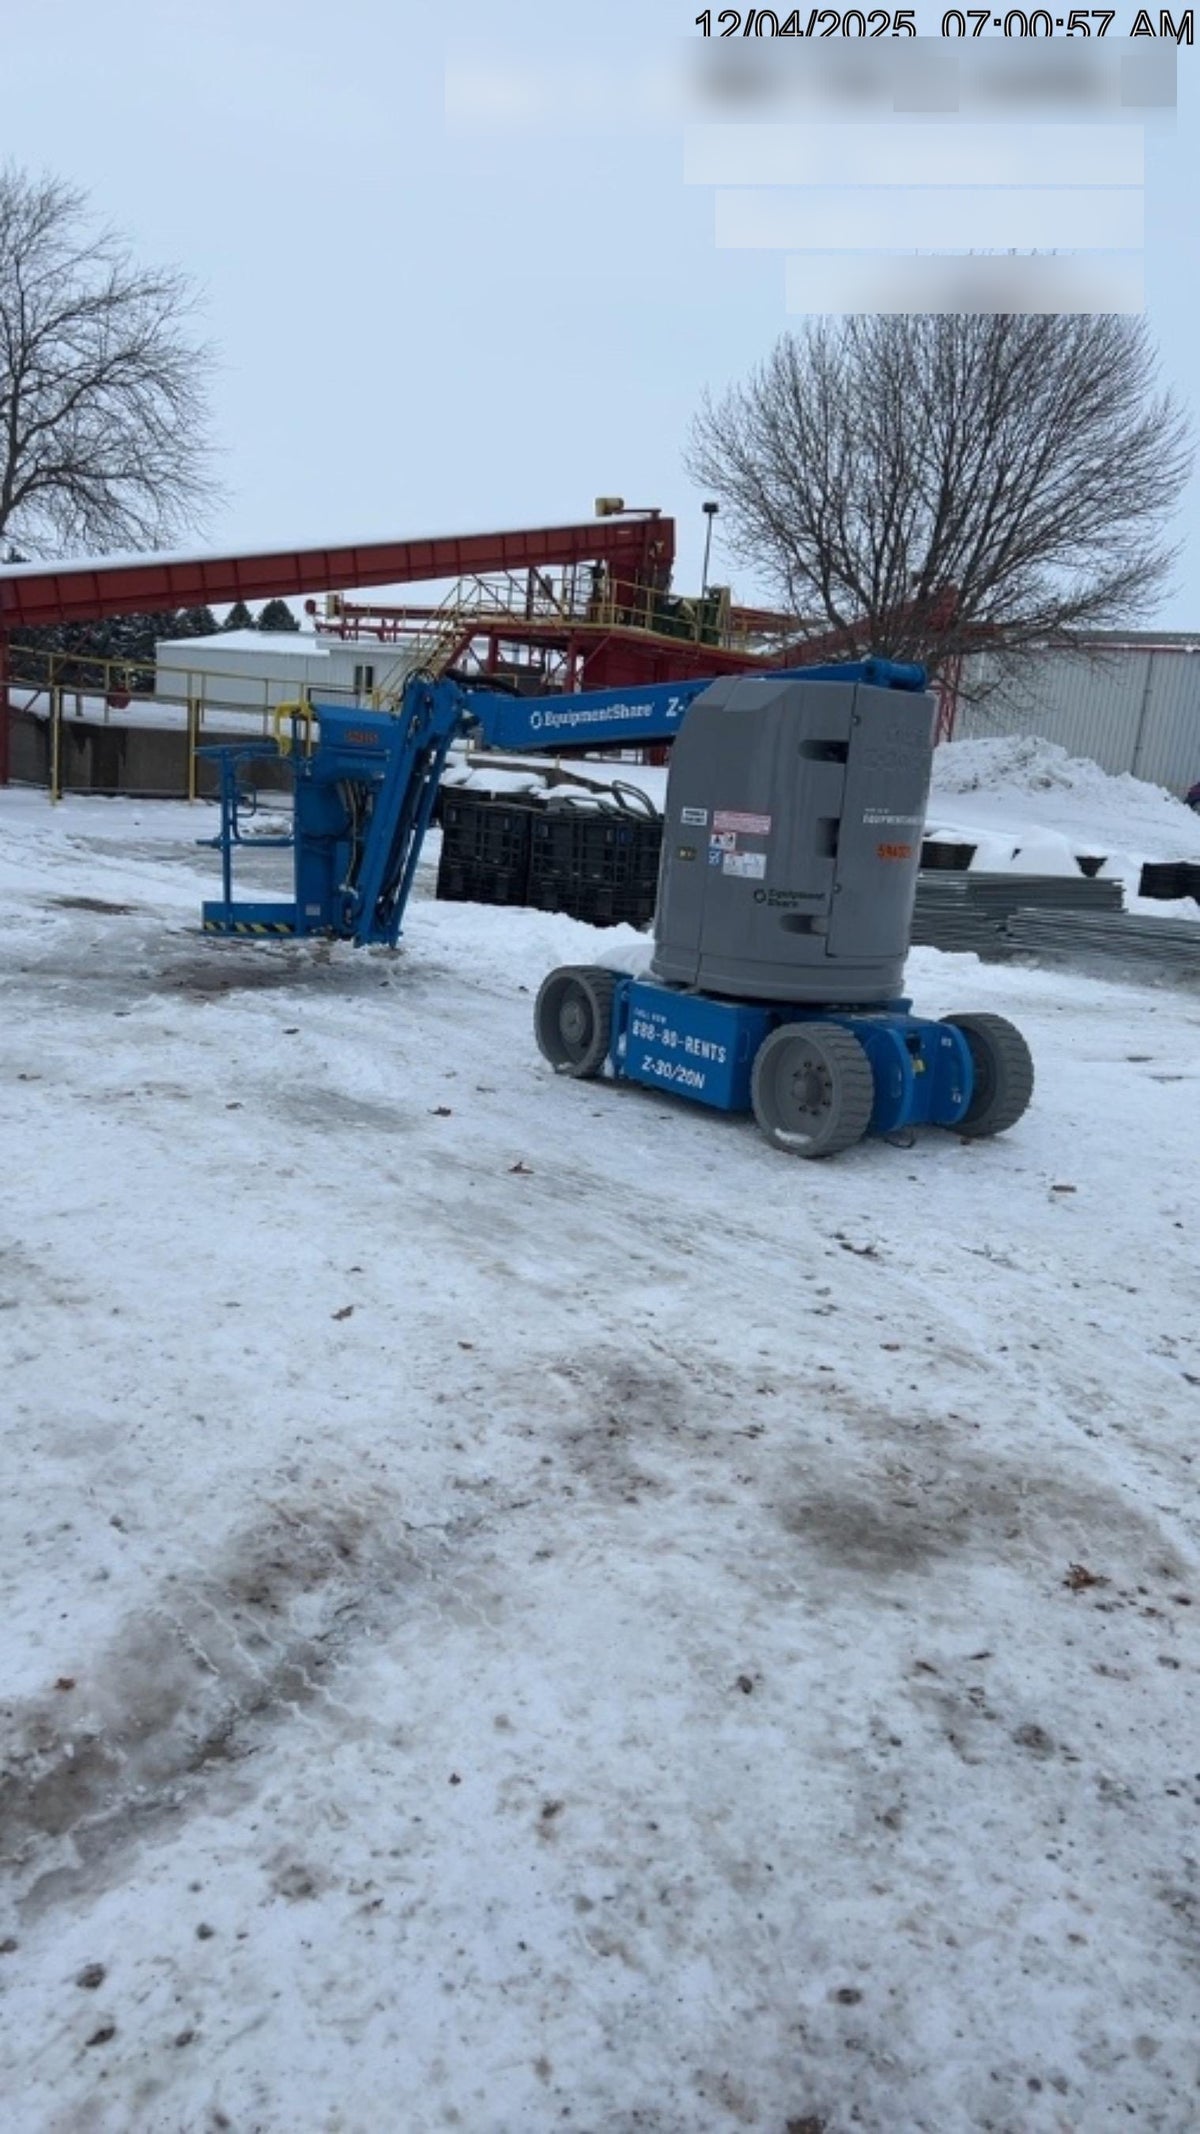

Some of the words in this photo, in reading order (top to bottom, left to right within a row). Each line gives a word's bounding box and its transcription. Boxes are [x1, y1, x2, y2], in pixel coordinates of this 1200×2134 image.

[544, 703, 654, 727] EquipmentShare
[632, 1019, 727, 1063] 888-80-RENTS
[641, 1054, 706, 1089] Z-30/20N
